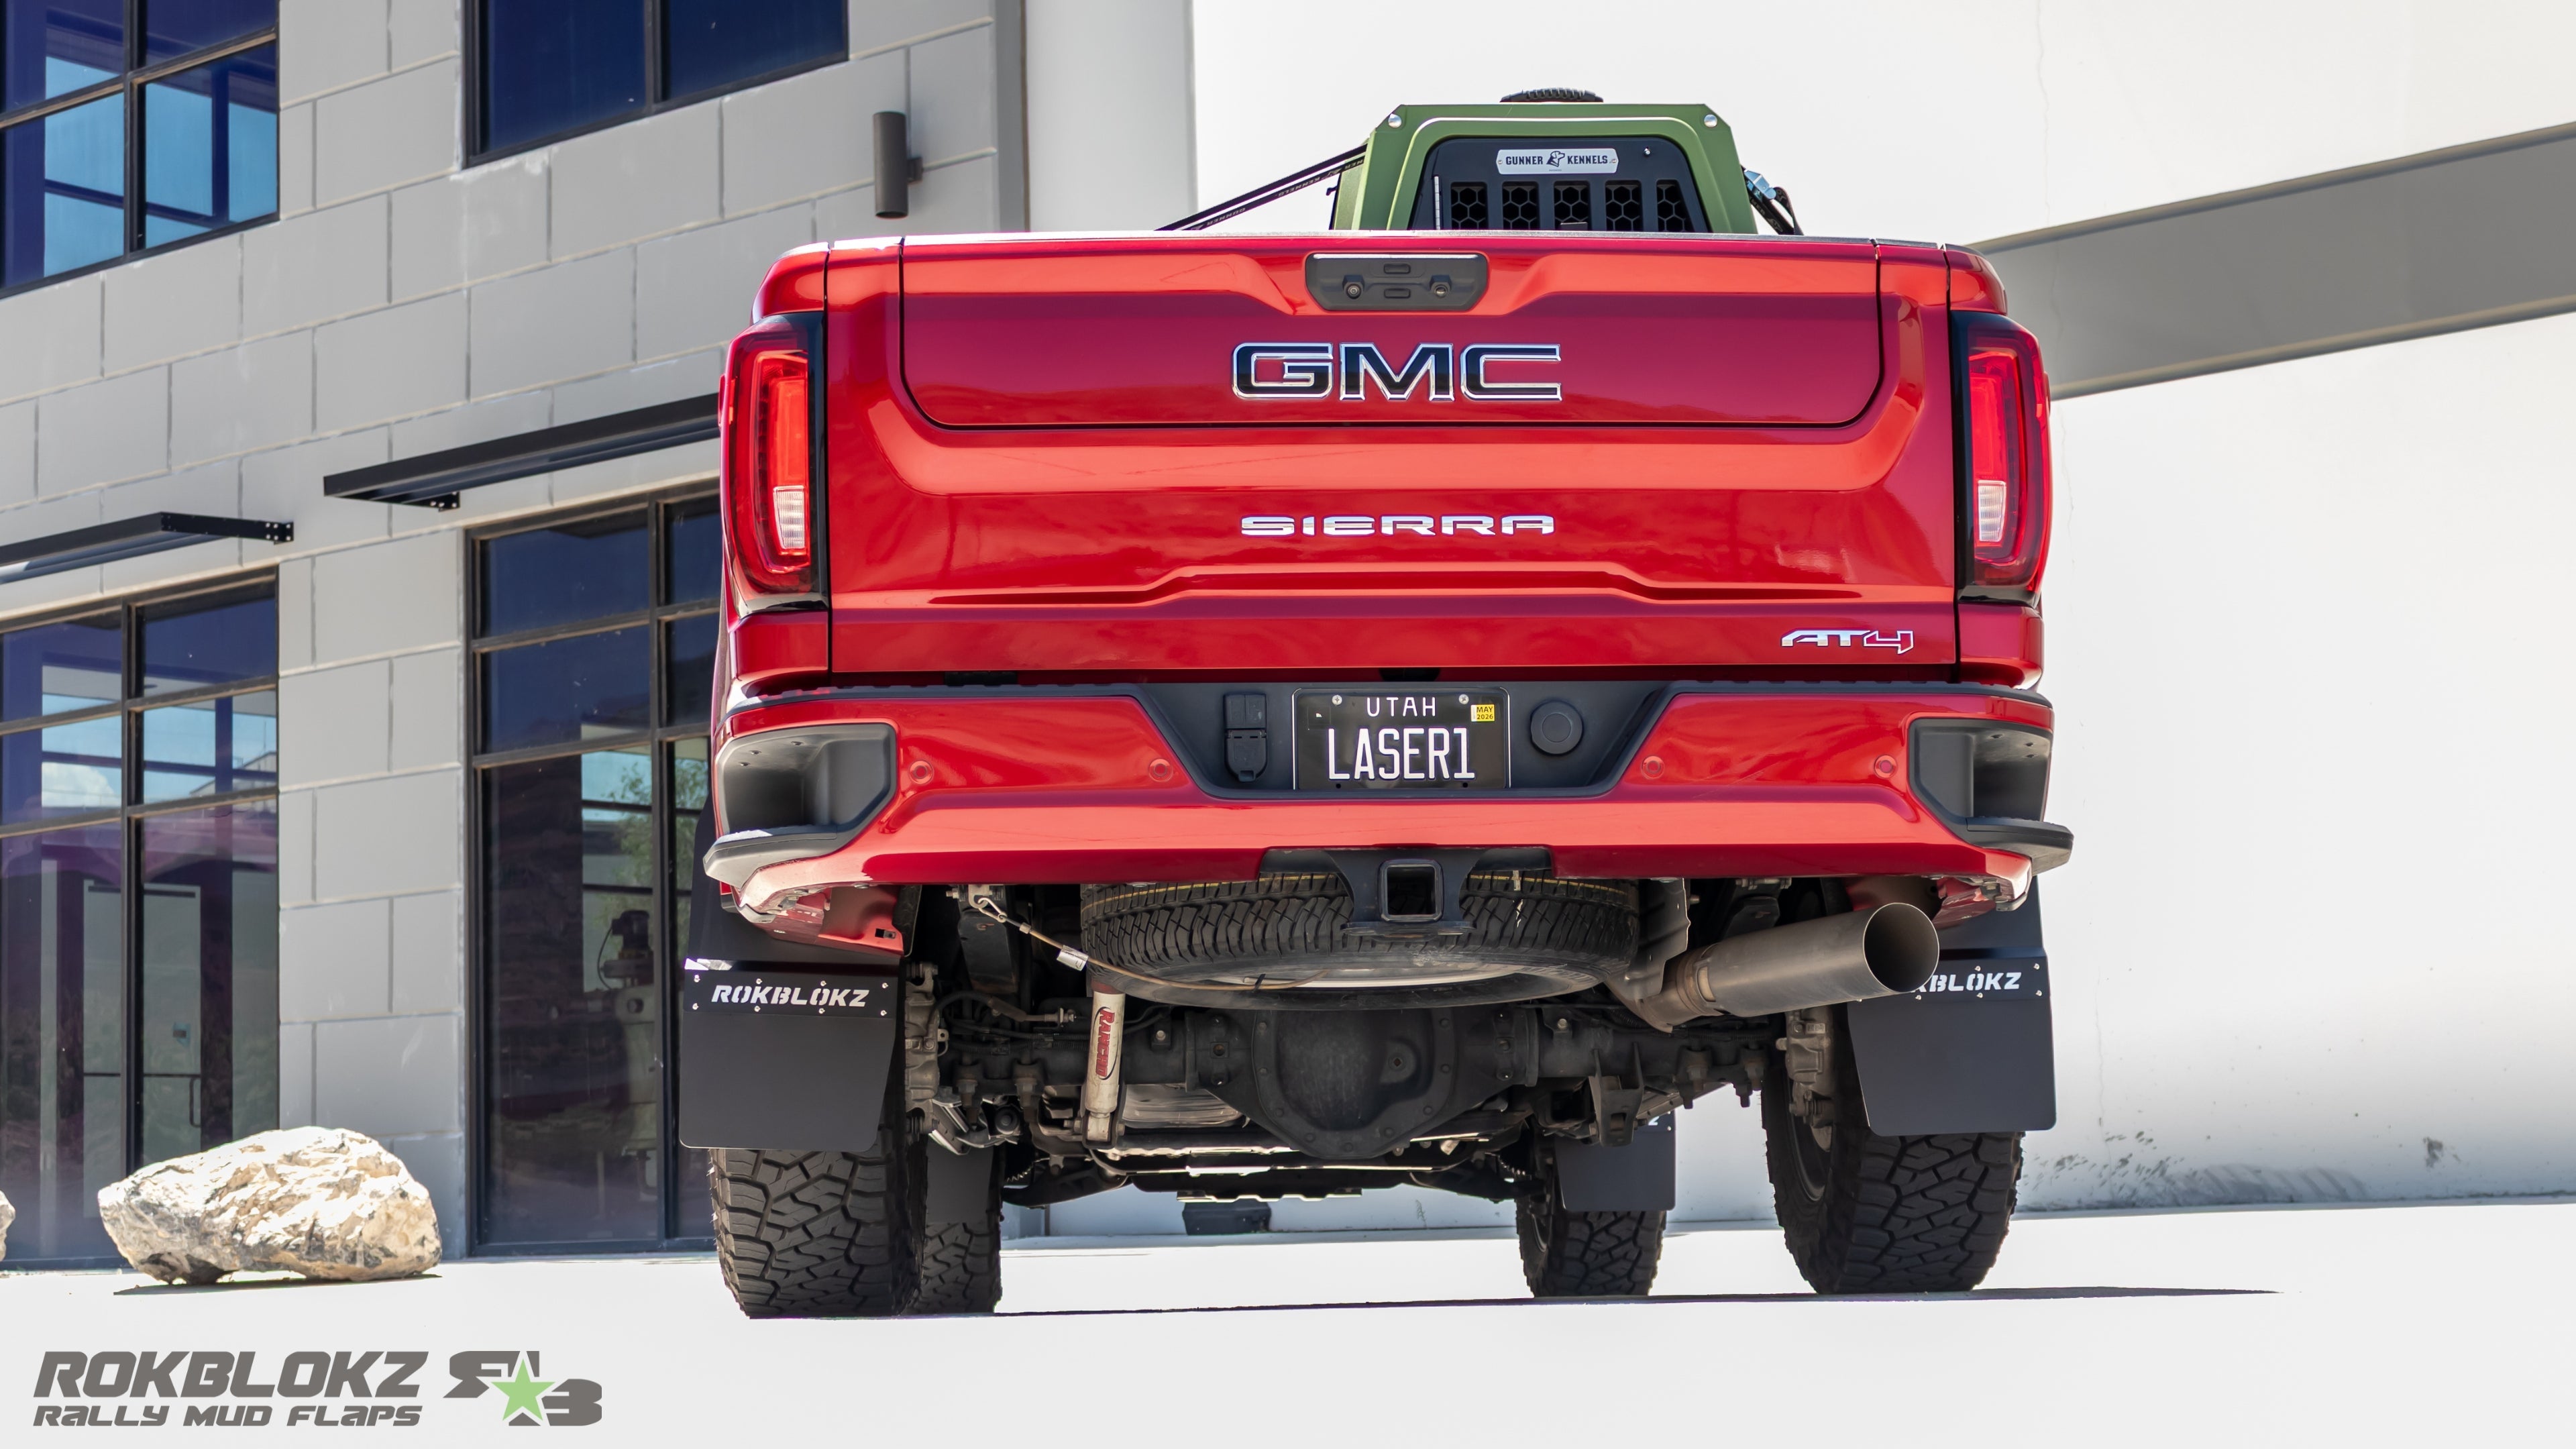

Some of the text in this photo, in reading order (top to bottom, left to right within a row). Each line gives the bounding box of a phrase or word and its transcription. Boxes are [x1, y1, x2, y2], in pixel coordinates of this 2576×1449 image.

[1505, 155, 1608, 165] GUNNER KENNELS
[1232, 342, 1562, 401] GMC
[1241, 516, 1554, 536] SIERRA
[1781, 630, 1914, 654] AT4
[1366, 696, 1436, 717] UTAH
[1328, 727, 1475, 780] LASER1
[1911, 971, 2022, 992] BLOKZ
[711, 985, 870, 1008] ROKBLOKZ
[1095, 1008, 1116, 1077] RANCHO
